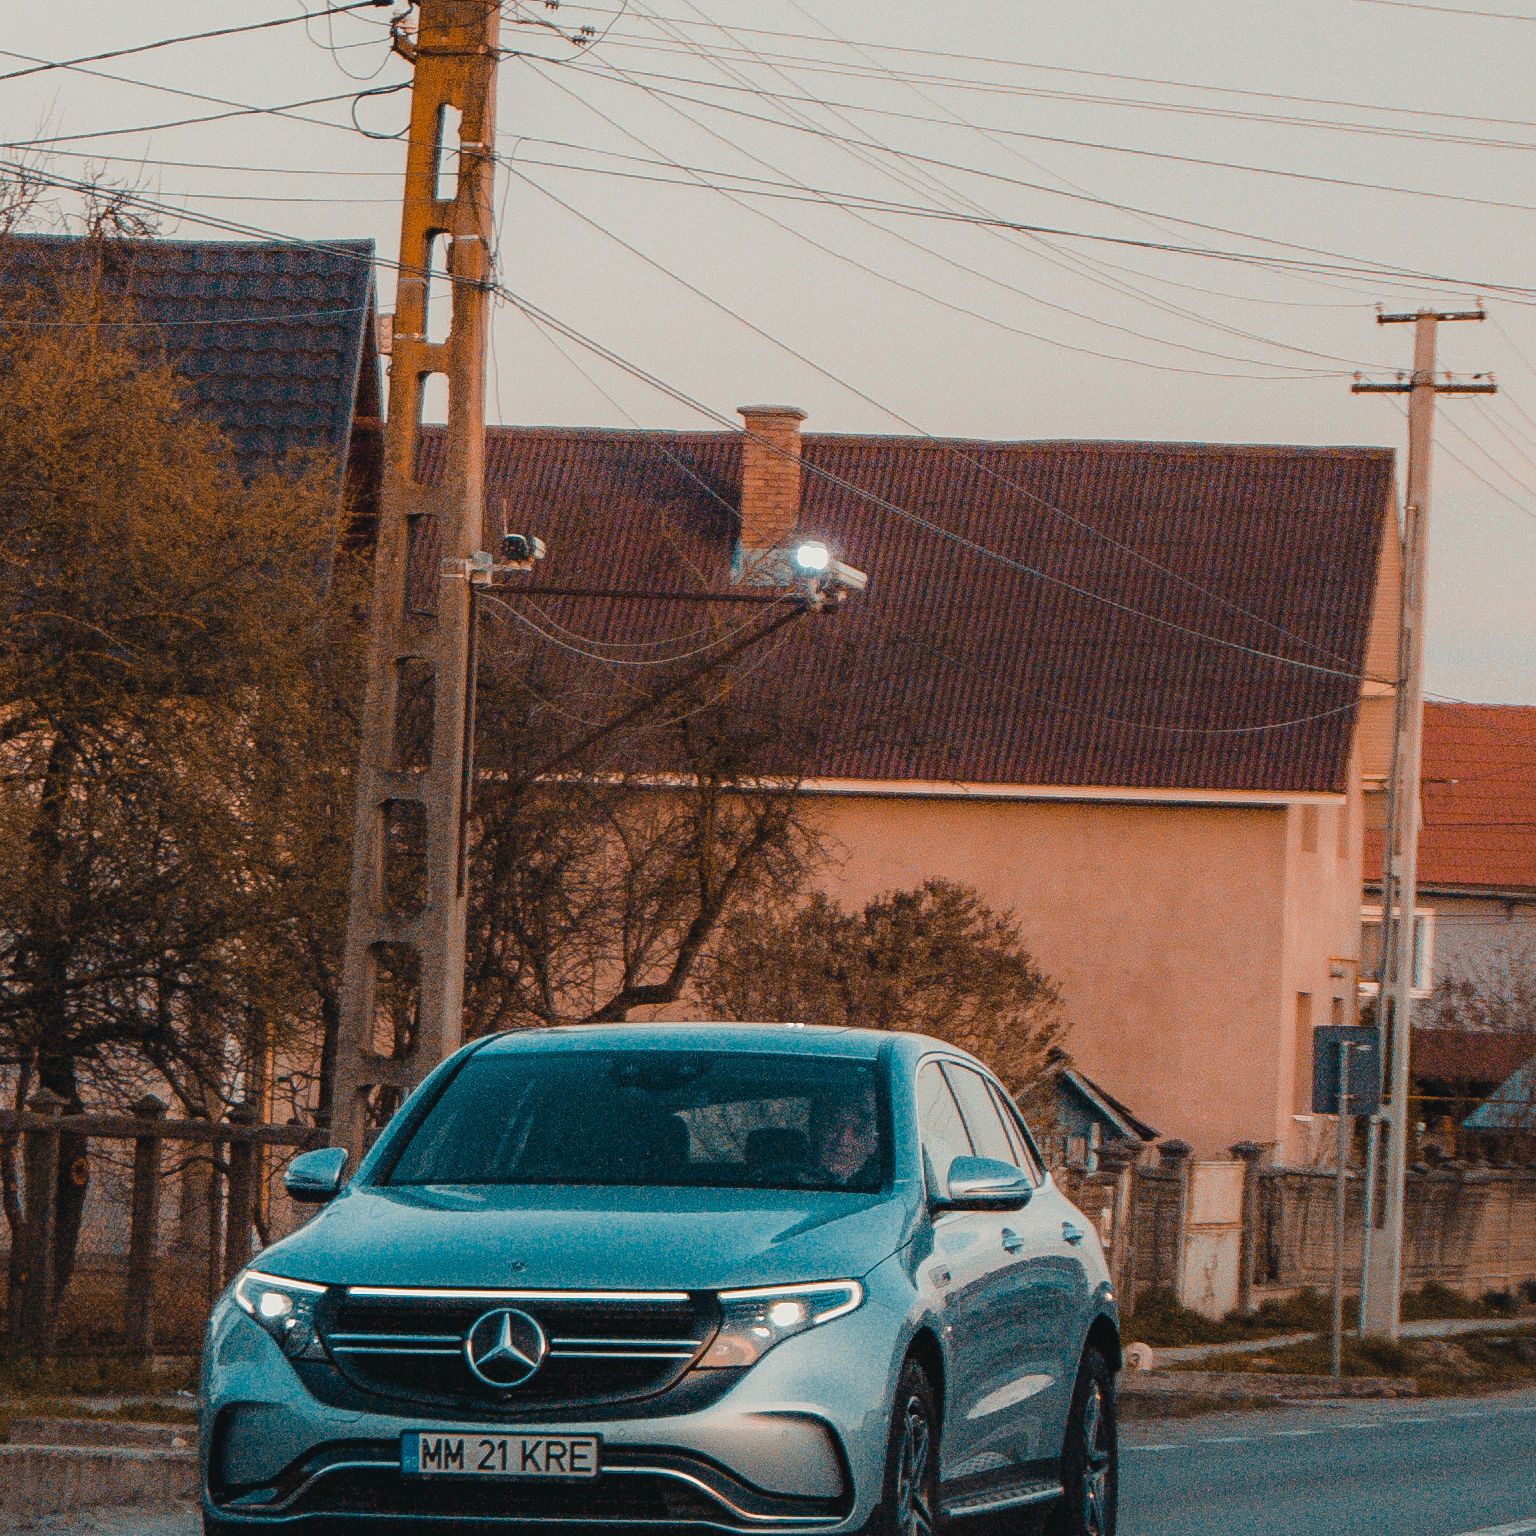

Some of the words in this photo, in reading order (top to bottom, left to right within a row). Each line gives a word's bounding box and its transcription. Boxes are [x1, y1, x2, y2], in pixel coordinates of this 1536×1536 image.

[421, 1438, 464, 1470] MM
[477, 1439, 508, 1471] 21
[520, 1440, 592, 1472] KRE
